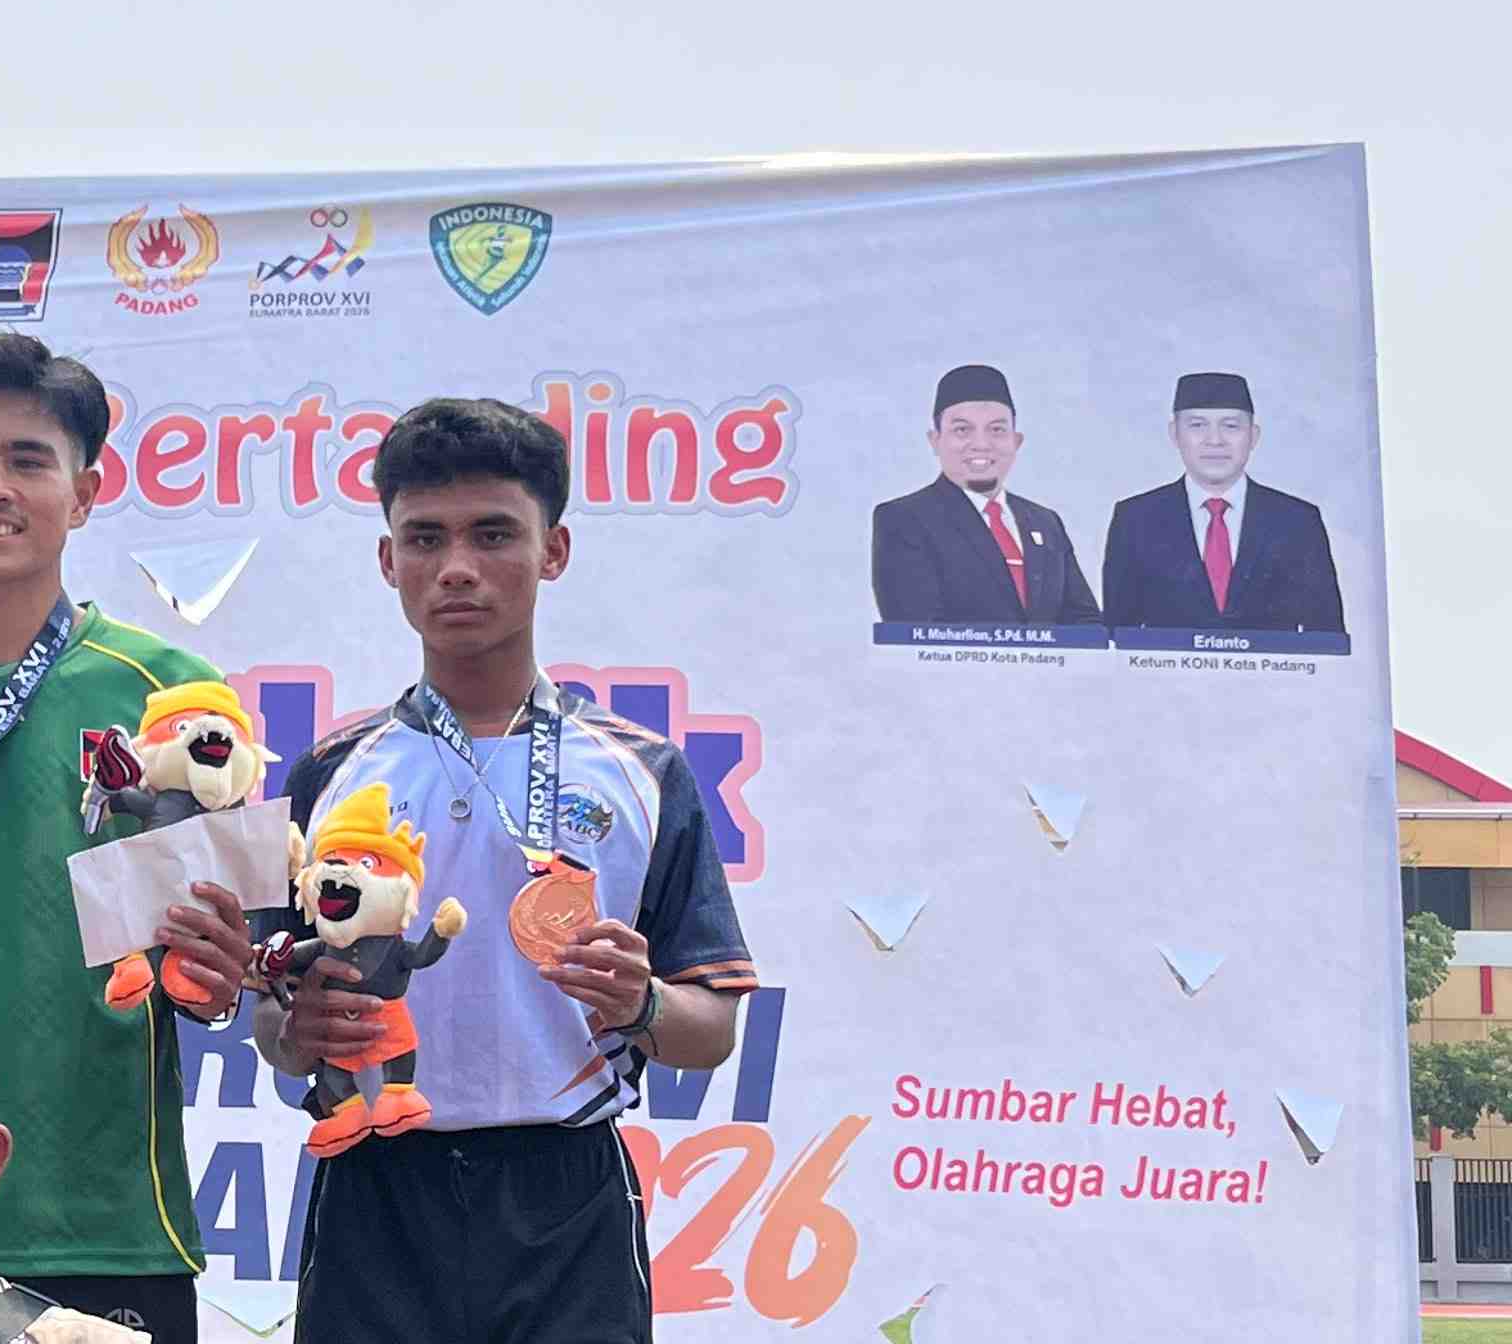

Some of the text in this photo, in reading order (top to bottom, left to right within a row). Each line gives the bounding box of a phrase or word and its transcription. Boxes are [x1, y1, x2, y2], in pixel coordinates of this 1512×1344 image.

[437, 206, 544, 232] INDONESIA
[114, 291, 199, 316] PADANG
[250, 291, 371, 307] PORPROV XVI
[1193, 634, 1251, 650] Erianto
[12, 641, 48, 686] XVI
[917, 650, 1066, 667] Ketua DPRD Kota Padang
[1129, 655, 1316, 675] Ketum KONI Kota Padang
[532, 722, 550, 765] XVI
[891, 1073, 1239, 1138] Sumbar Hebat,
[891, 1144, 1269, 1210] Olahraga Juara!
